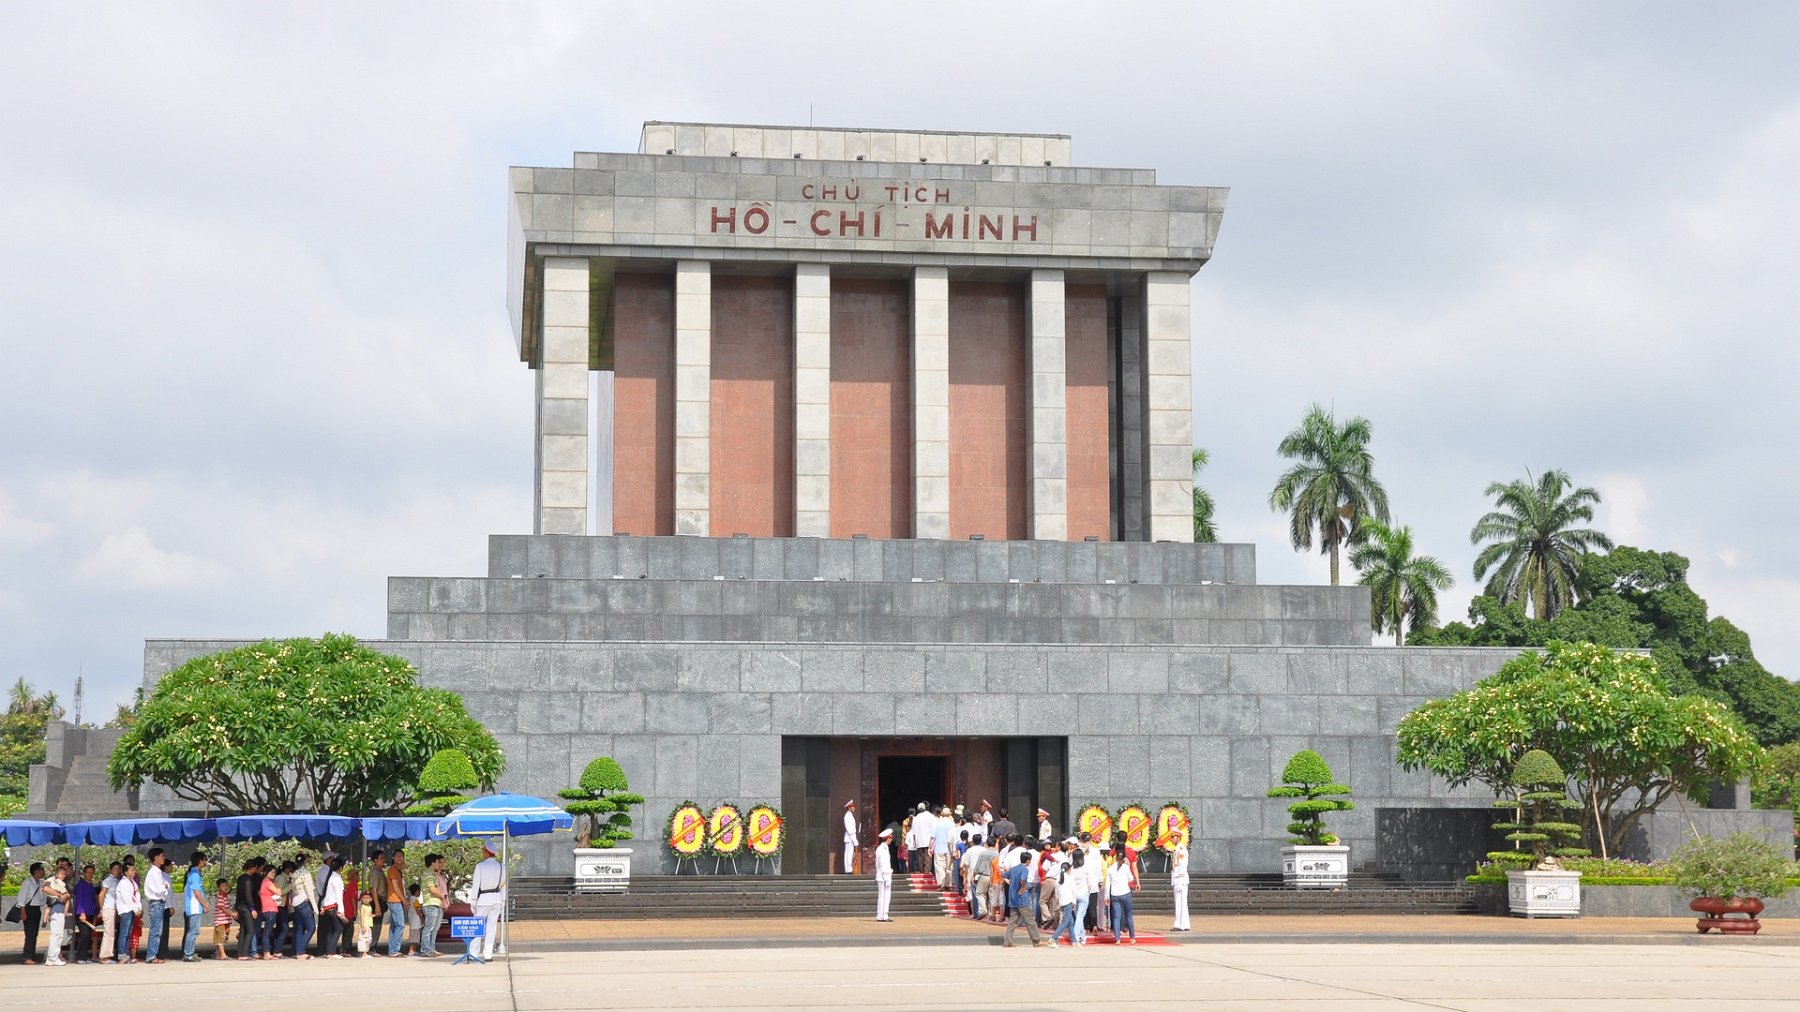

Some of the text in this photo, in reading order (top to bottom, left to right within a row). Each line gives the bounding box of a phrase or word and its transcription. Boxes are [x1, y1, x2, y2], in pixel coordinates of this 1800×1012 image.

[802, 178, 950, 209] CHỦ TỊCH
[710, 201, 773, 235] HỒ
[809, 204, 885, 238] CHÍ
